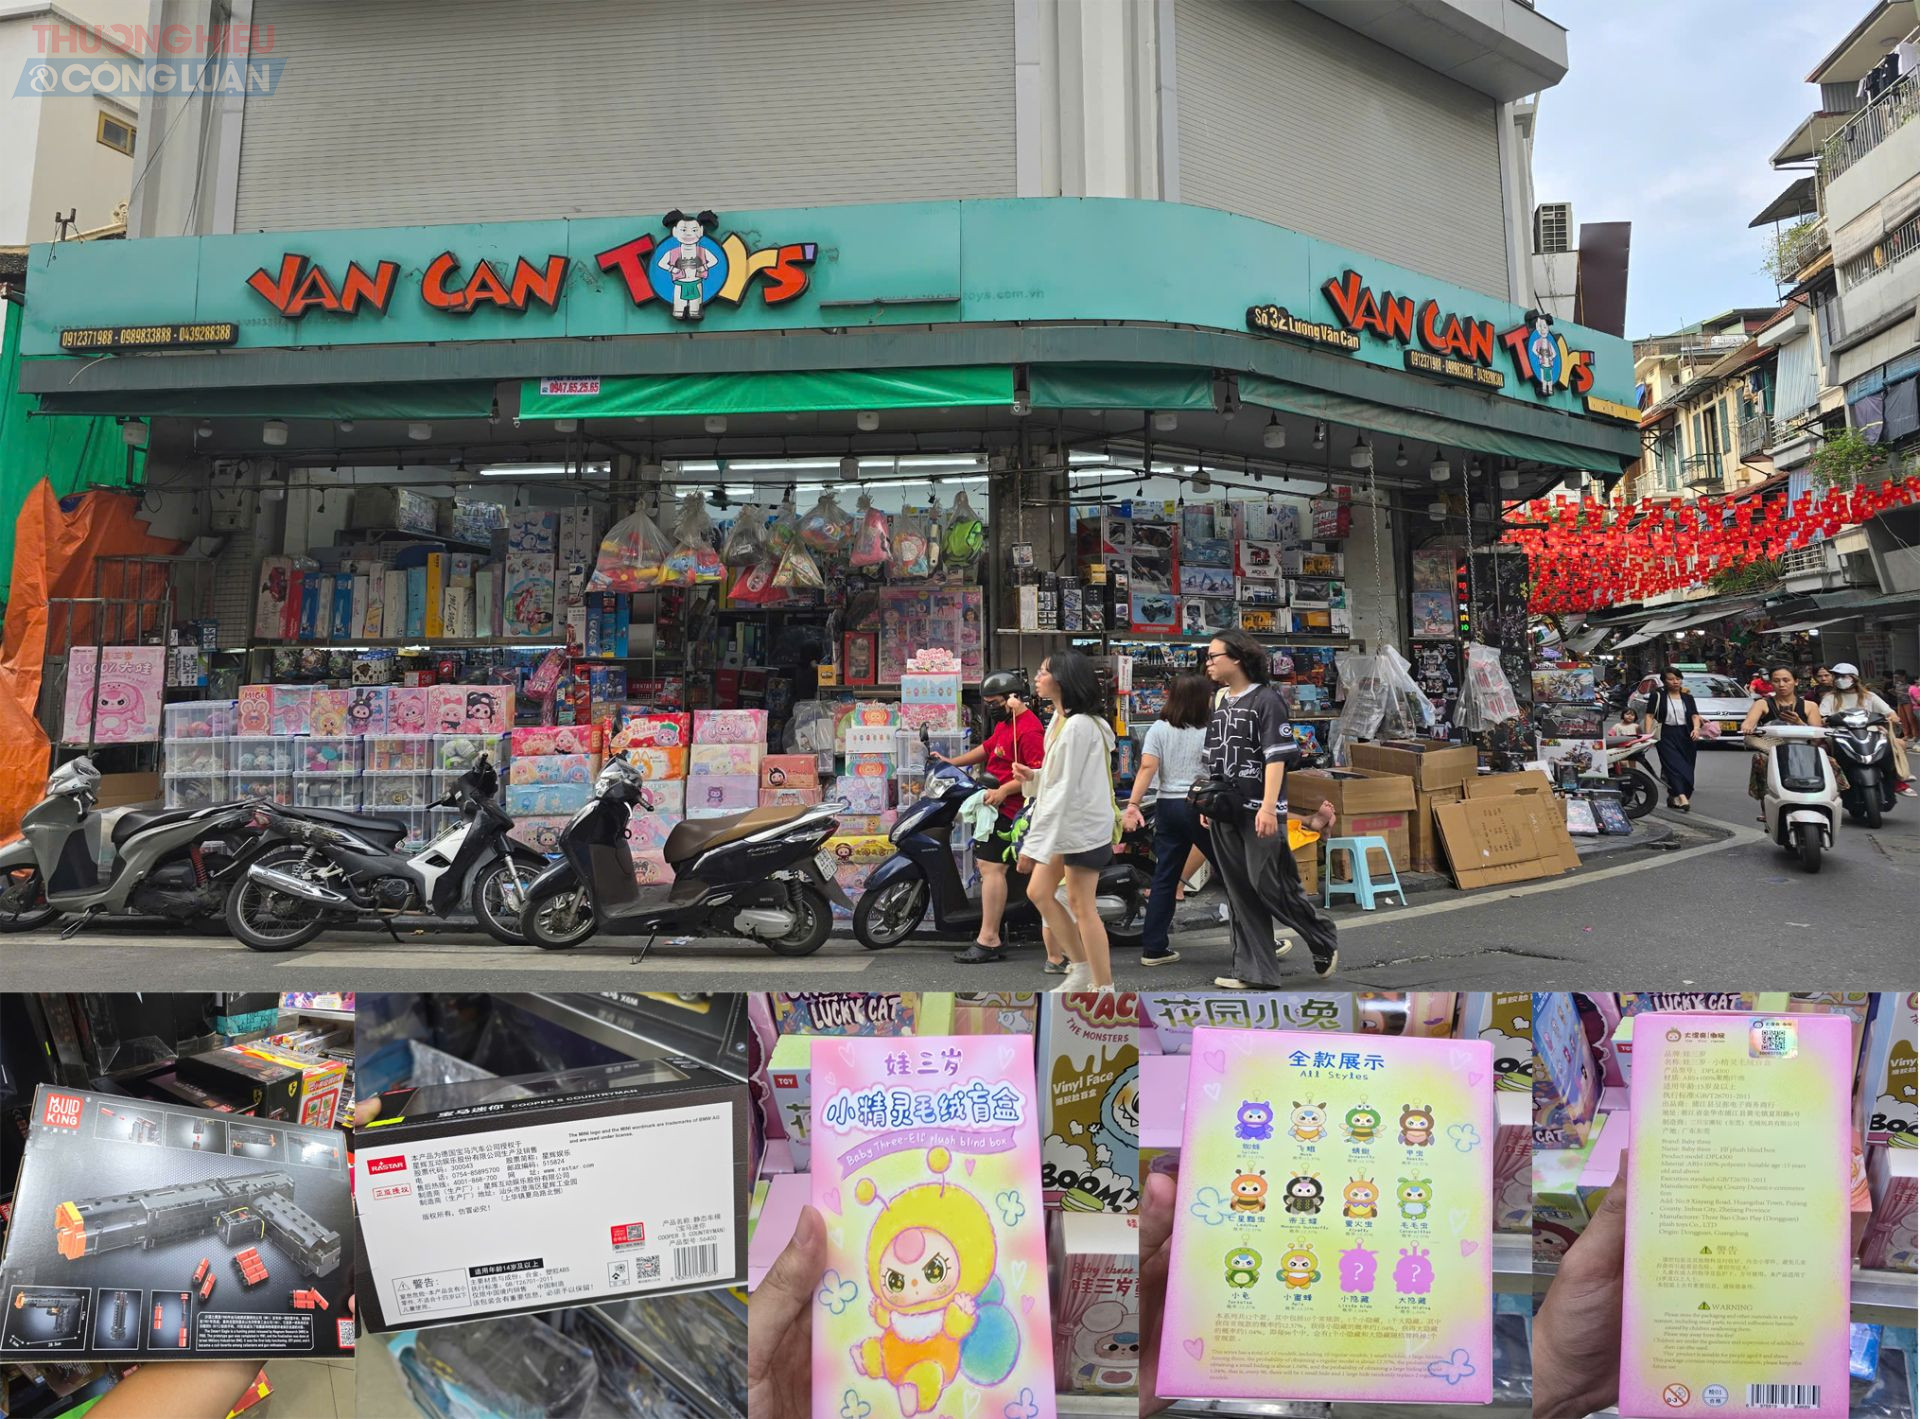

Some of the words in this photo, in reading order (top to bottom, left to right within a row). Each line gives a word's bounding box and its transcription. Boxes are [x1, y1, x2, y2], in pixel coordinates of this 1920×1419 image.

[247, 253, 400, 318] VAN
[421, 251, 569, 314] CAN
[1255, 308, 1268, 327] Số
[1269, 307, 1288, 330] 32
[1289, 317, 1320, 341] Lương
[1320, 325, 1340, 343] Văn
[1320, 270, 1415, 345] VAN
[1417, 298, 1495, 366] CAN
[62, 330, 113, 347] 0912371988
[120, 327, 171, 345] 0989833888
[179, 324, 231, 342] 0439288388
[811, 999, 866, 1030] LUCKY
[868, 997, 901, 1022] CAT
[1153, 998, 1341, 1030] 花园小兔
[1654, 994, 1704, 1011] LUCKY
[1707, 993, 1741, 1011] CAT
[1066, 1017, 1082, 1036] THE
[1082, 1031, 1129, 1043] MONSTERS
[885, 1048, 962, 1076] 娃三岁
[1288, 1050, 1384, 1070] 全款展示
[1053, 1076, 1083, 1095] Vinyl
[1087, 1071, 1114, 1087] Face
[1300, 1070, 1320, 1079] All
[1328, 1071, 1369, 1081] Styles
[49, 1096, 80, 1115] MOULD
[511, 1098, 555, 1109] COOPER
[566, 1088, 639, 1101] COUNTRYMAN
[826, 1082, 1020, 1127] 小精灵毛绒盲盒
[46, 1112, 78, 1125] KING
[1536, 1129, 1564, 1142] CAT
[845, 1148, 873, 1164] Baby
[959, 1134, 986, 1147] blind
[989, 1136, 1008, 1146] box
[371, 1161, 404, 1172] RASTAR
